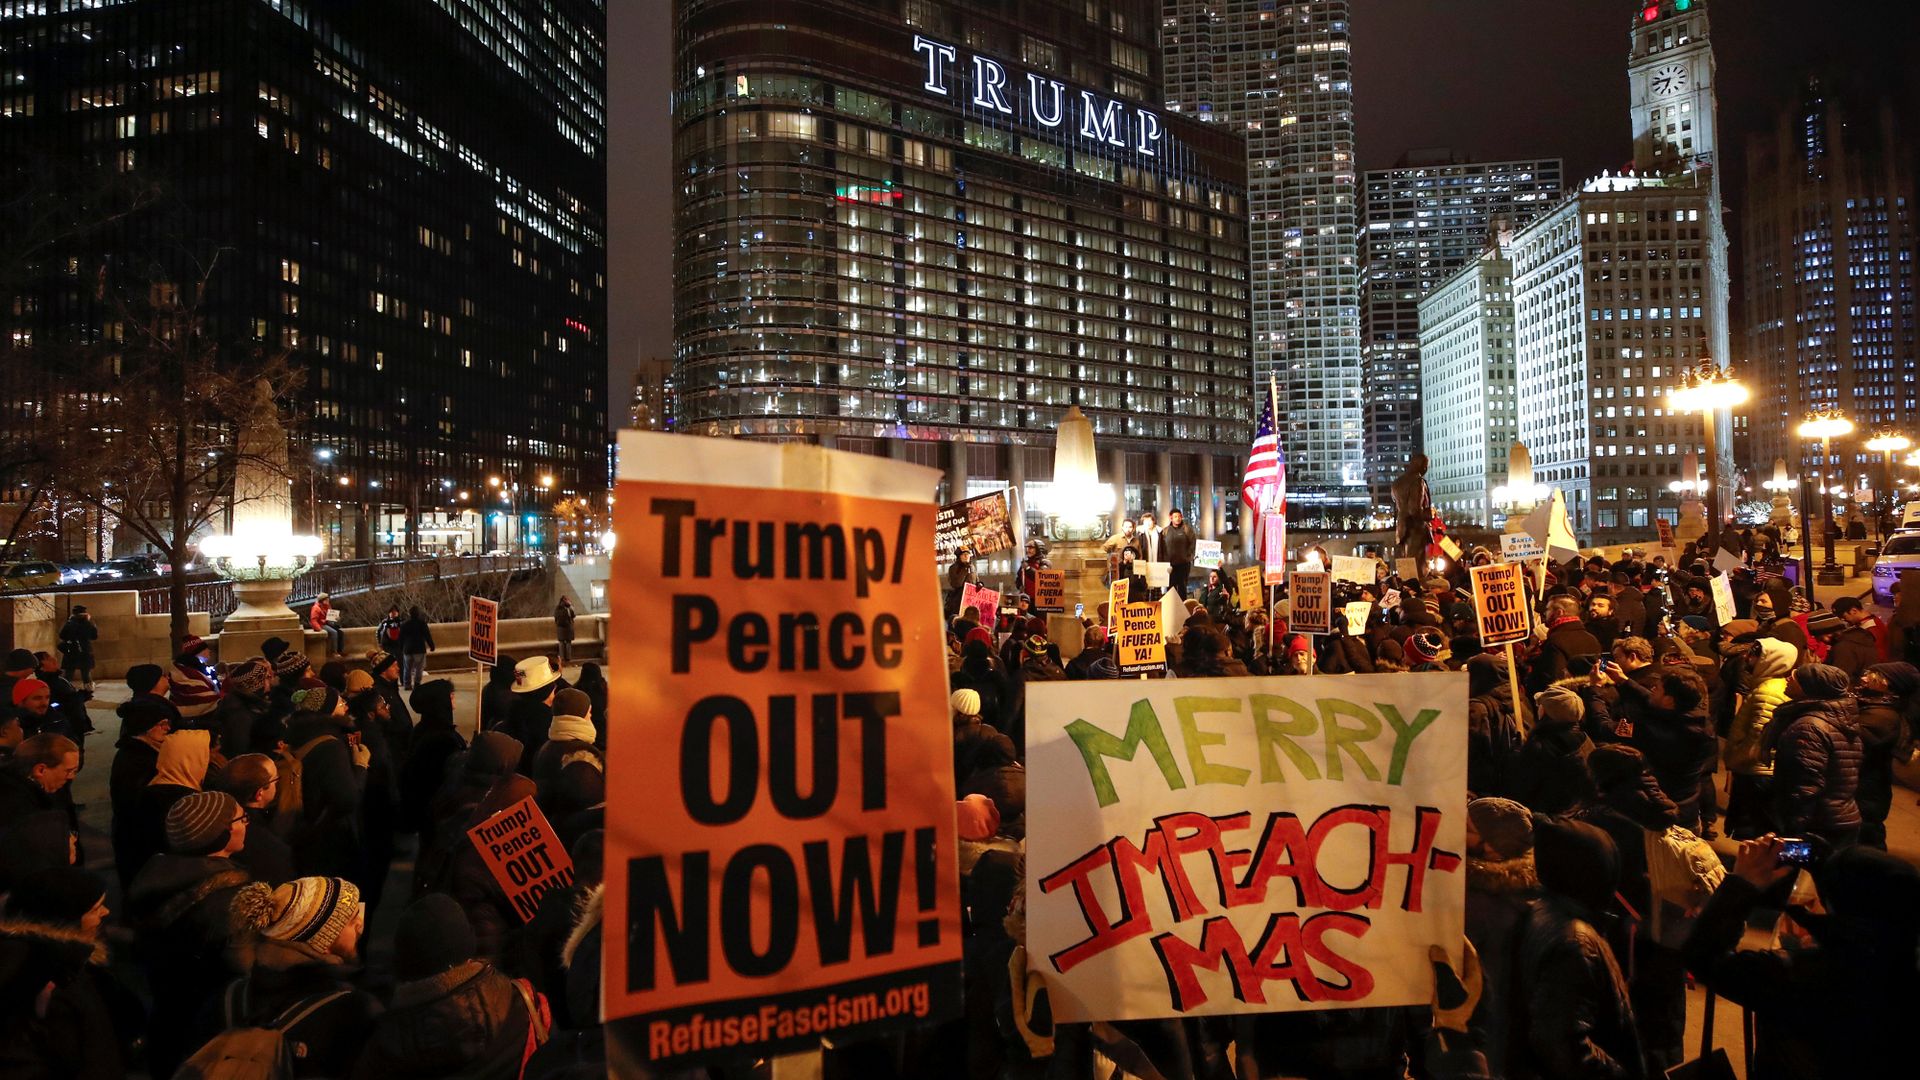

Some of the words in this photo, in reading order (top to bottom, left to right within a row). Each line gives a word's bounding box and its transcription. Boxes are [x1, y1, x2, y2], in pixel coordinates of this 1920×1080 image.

[914, 34, 1162, 156] TRUMP
[650, 497, 912, 597] Trump/
[1038, 572, 1062, 580] Trump/
[1293, 574, 1325, 584] Trump/
[1477, 565, 1515, 582] Trump/
[1037, 589, 1063, 597] ¡FUERA
[1296, 585, 1322, 593] Pence
[1482, 580, 1515, 594] Pence
[474, 600, 494, 614] Trump/
[1297, 595, 1322, 609] OUT
[1486, 593, 1516, 613] OUT
[474, 610, 492, 623] Pence
[1120, 604, 1158, 619] Trump/
[1293, 610, 1326, 625] NOW!
[475, 622, 491, 638] OUT
[1124, 620, 1156, 632] Pence
[1483, 611, 1525, 634] NOW!
[671, 593, 903, 675] Pence
[1122, 632, 1161, 648] ¡FUERA
[471, 636, 494, 655] NOW!
[1134, 648, 1152, 661] YA!
[679, 691, 902, 826] OUT
[1063, 694, 1442, 808] MERRY
[475, 802, 533, 845] Trump/
[490, 825, 542, 861] Pence
[506, 843, 554, 887] OUT
[1039, 803, 1462, 974] IMPEACH-
[626, 827, 940, 995] NOW!
[1150, 912, 1376, 1013] MAS
[650, 982, 930, 1061] RefuseFascism.org
